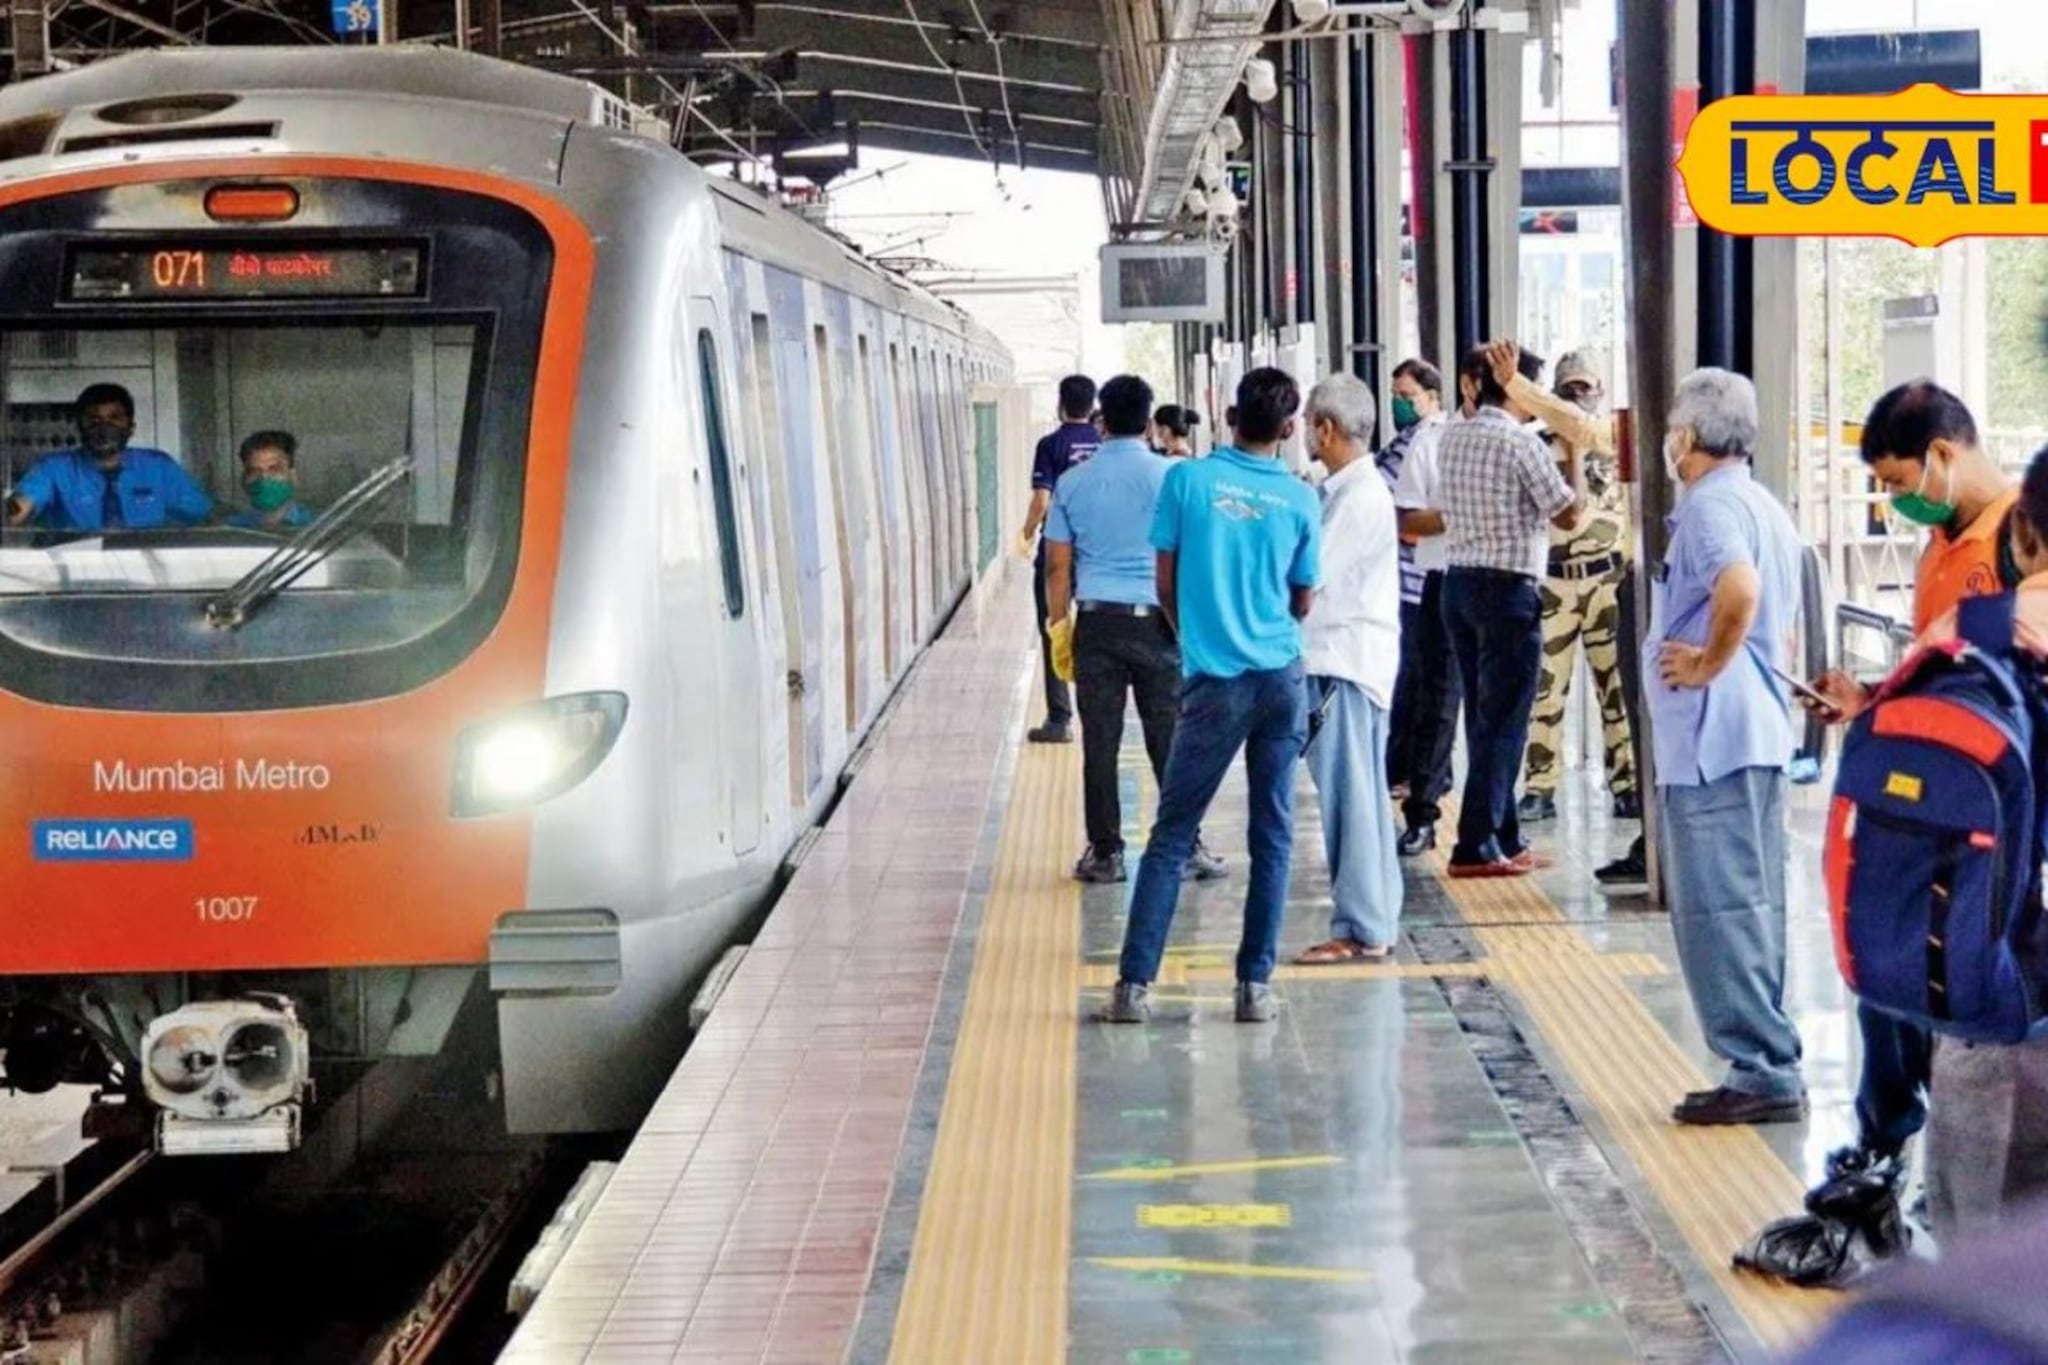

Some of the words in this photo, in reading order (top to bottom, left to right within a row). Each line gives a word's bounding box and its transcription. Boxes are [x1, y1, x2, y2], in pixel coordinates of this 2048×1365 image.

[347, 6, 371, 30] 39
[153, 251, 204, 287] 071
[94, 759, 224, 791] Mumbai
[236, 758, 331, 789] Metro
[195, 897, 259, 921] 1007
